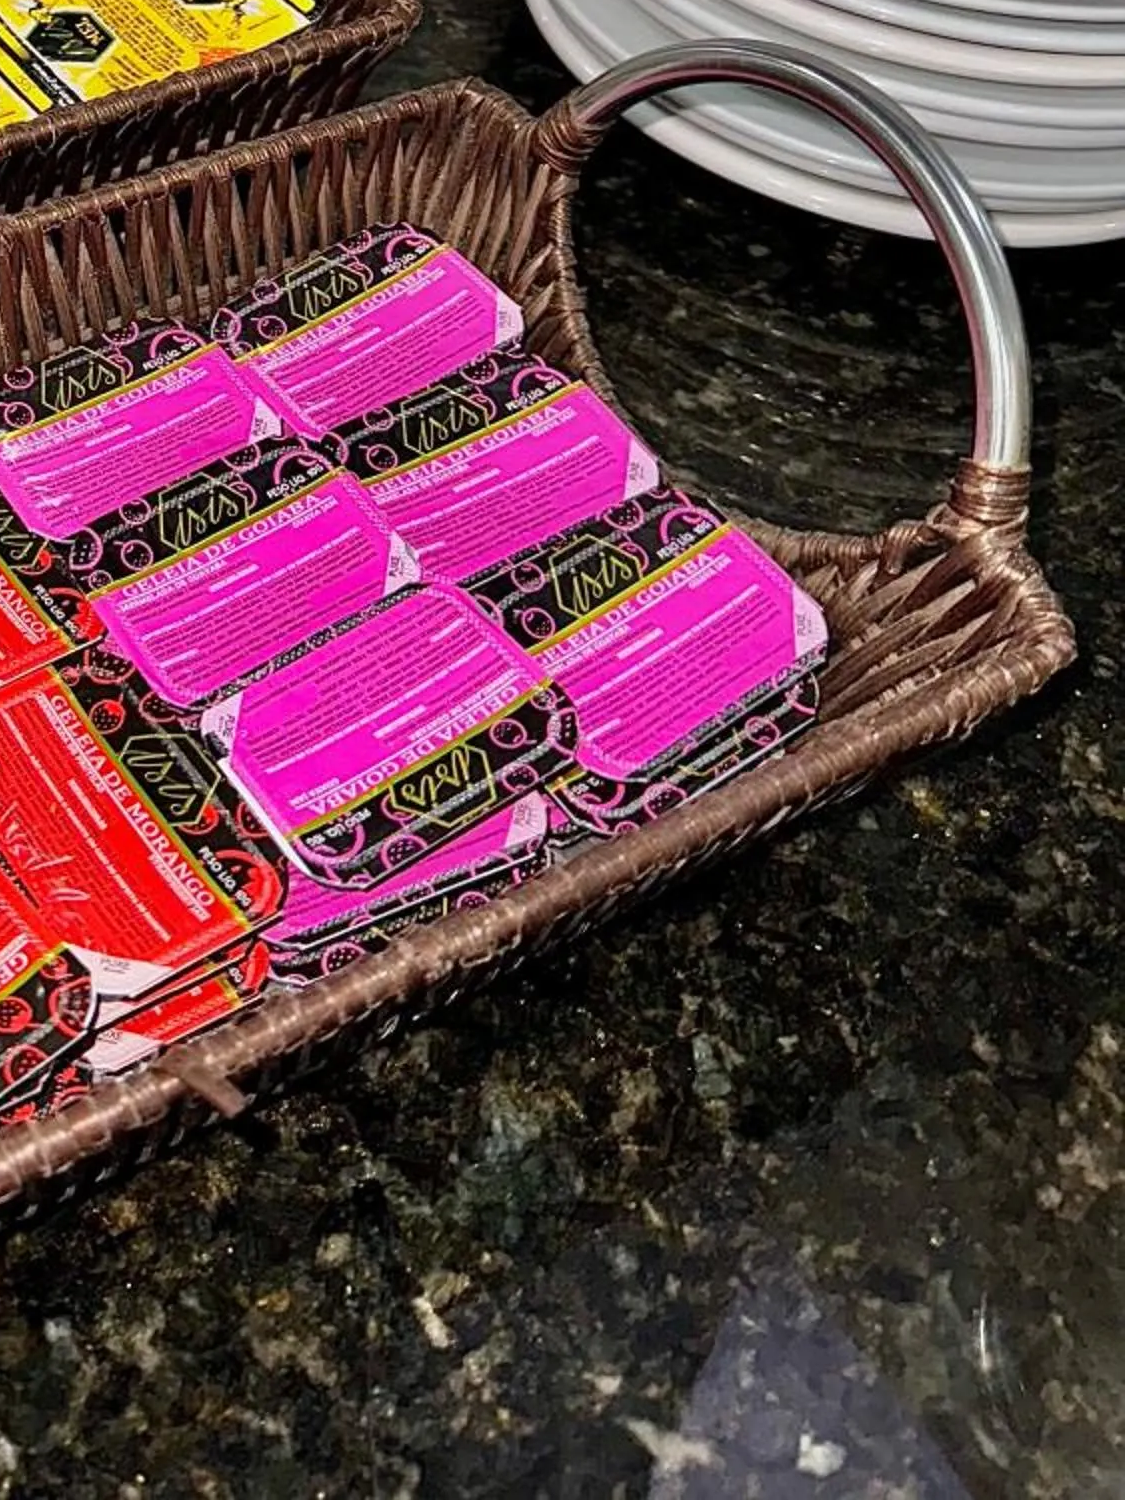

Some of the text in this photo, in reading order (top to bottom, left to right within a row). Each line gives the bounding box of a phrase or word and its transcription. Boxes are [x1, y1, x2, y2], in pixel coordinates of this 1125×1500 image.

[75, 16, 102, 46] MEL
[81, 400, 112, 420] DE
[112, 363, 195, 407] GOIABA
[416, 399, 478, 451] isis
[447, 443, 478, 463] DE
[478, 403, 560, 449] GOIABA
[120, 491, 322, 599] GELEIA DE GOIABA
[174, 491, 238, 546] isis
[571, 551, 632, 612] isis
[605, 600, 636, 626] DE
[634, 550, 713, 606] GOIABA
[307, 682, 520, 818] GELEIA DE GOIABA
[403, 748, 472, 807] isis
[47, 693, 111, 768] GELEIA
[101, 769, 134, 801] DE
[124, 800, 219, 909] MORANGO
[127, 751, 201, 815] isis
